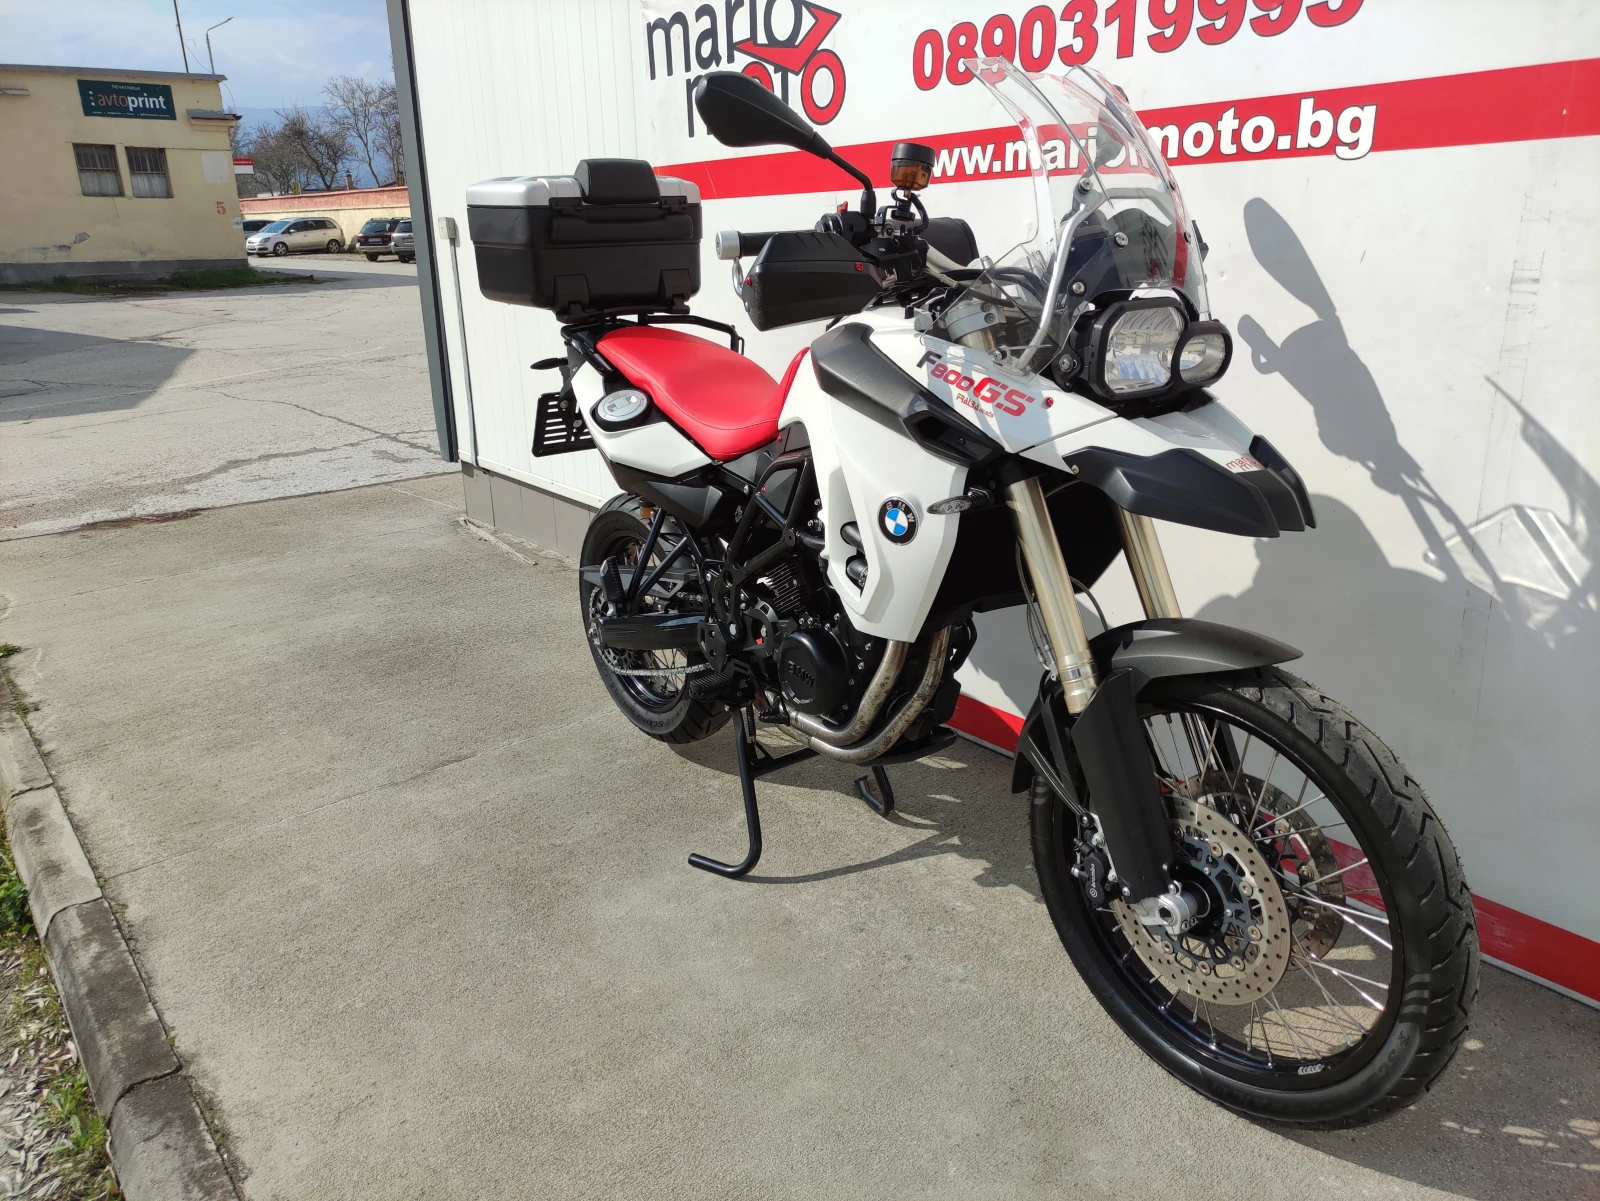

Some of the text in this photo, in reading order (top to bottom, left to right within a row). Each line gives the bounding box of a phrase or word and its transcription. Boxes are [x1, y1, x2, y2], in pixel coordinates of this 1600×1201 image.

[97, 93, 167, 111] avtoprint
[216, 201, 227, 215] 5
[885, 501, 915, 523] BMW
[788, 660, 816, 688] BMW
